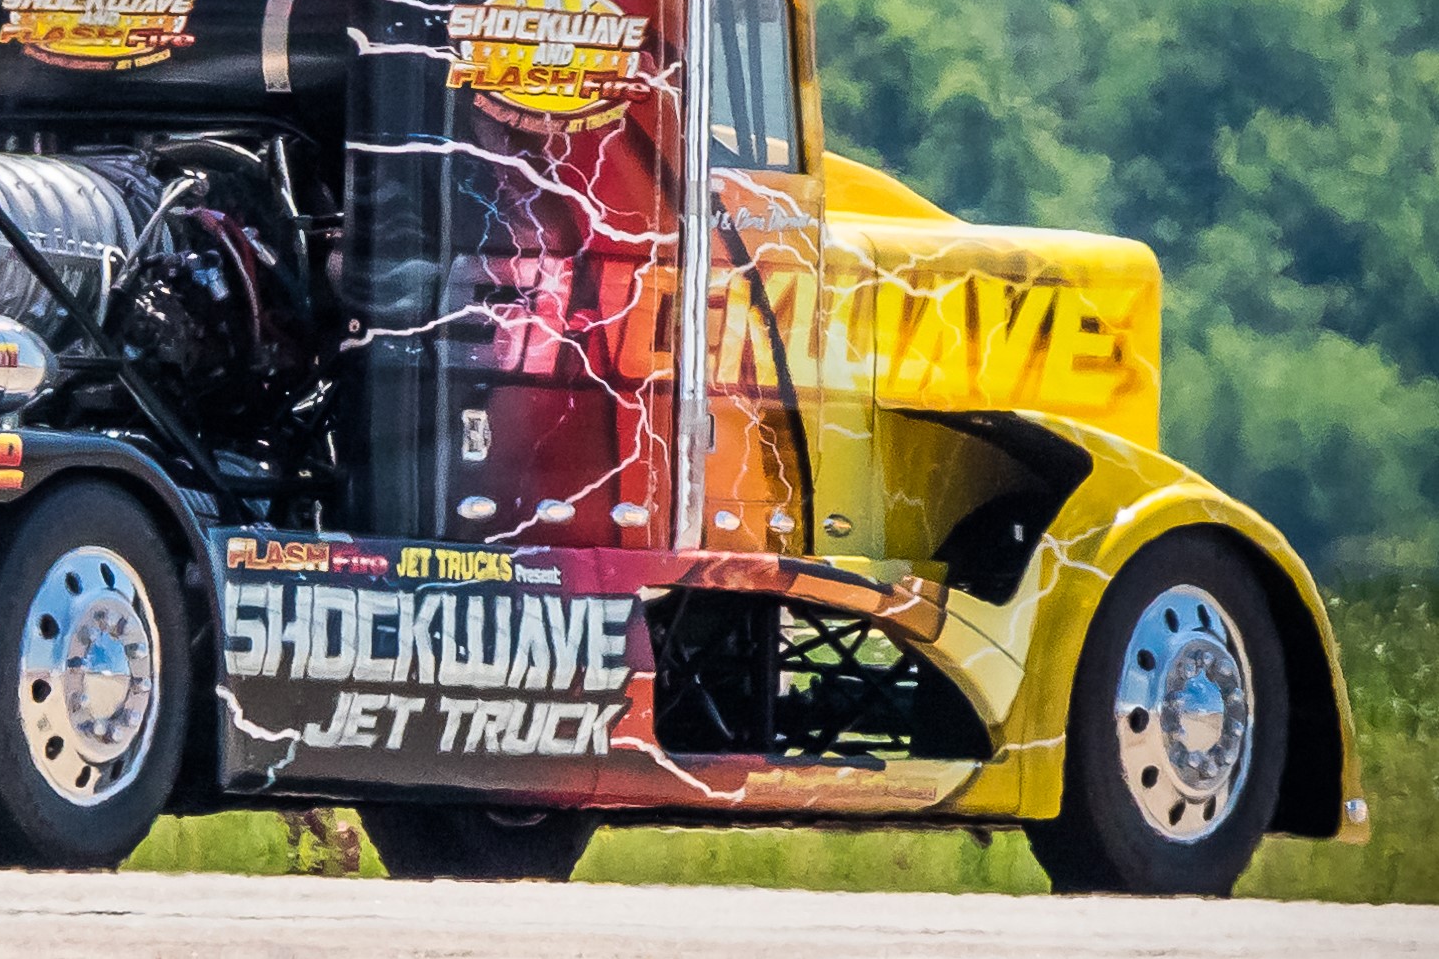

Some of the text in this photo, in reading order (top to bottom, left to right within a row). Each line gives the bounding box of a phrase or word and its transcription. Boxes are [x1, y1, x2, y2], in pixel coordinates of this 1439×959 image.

[450, 6, 649, 48] SHOCKWAVE
[448, 62, 578, 96] FLASH
[227, 537, 329, 572] FLASH
[397, 547, 432, 578] JET
[437, 549, 513, 582] TRUCKS
[225, 581, 634, 691] SHOCKWAVE
[303, 692, 626, 756] JET TRUCK
